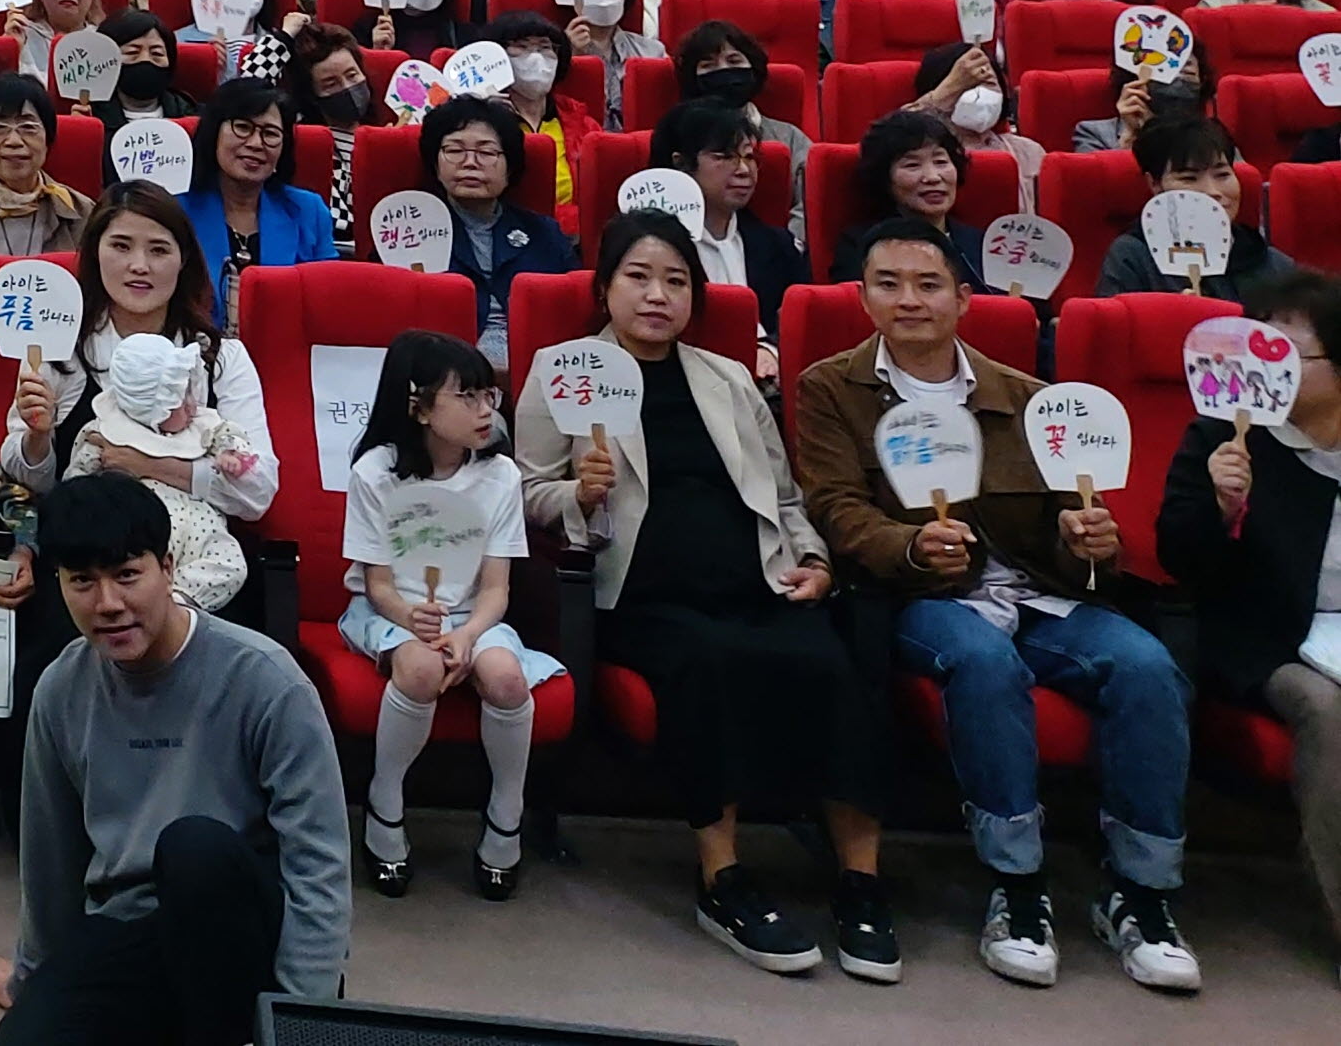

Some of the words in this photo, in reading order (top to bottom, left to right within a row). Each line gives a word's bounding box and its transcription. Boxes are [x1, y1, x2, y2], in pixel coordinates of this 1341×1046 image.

[58, 46, 88, 70] 아이는
[124, 132, 164, 149] 아이는
[118, 148, 187, 174] 기쁨입니다
[626, 181, 666, 201] 아이는
[382, 204, 422, 222] 아이는
[379, 223, 449, 250] 행운입니다
[1001, 222, 1044, 240] 아이는
[1, 274, 49, 293] 아이는
[554, 353, 605, 371] 아이는
[549, 373, 638, 406] 소중합니다
[1038, 397, 1089, 417] 아이는
